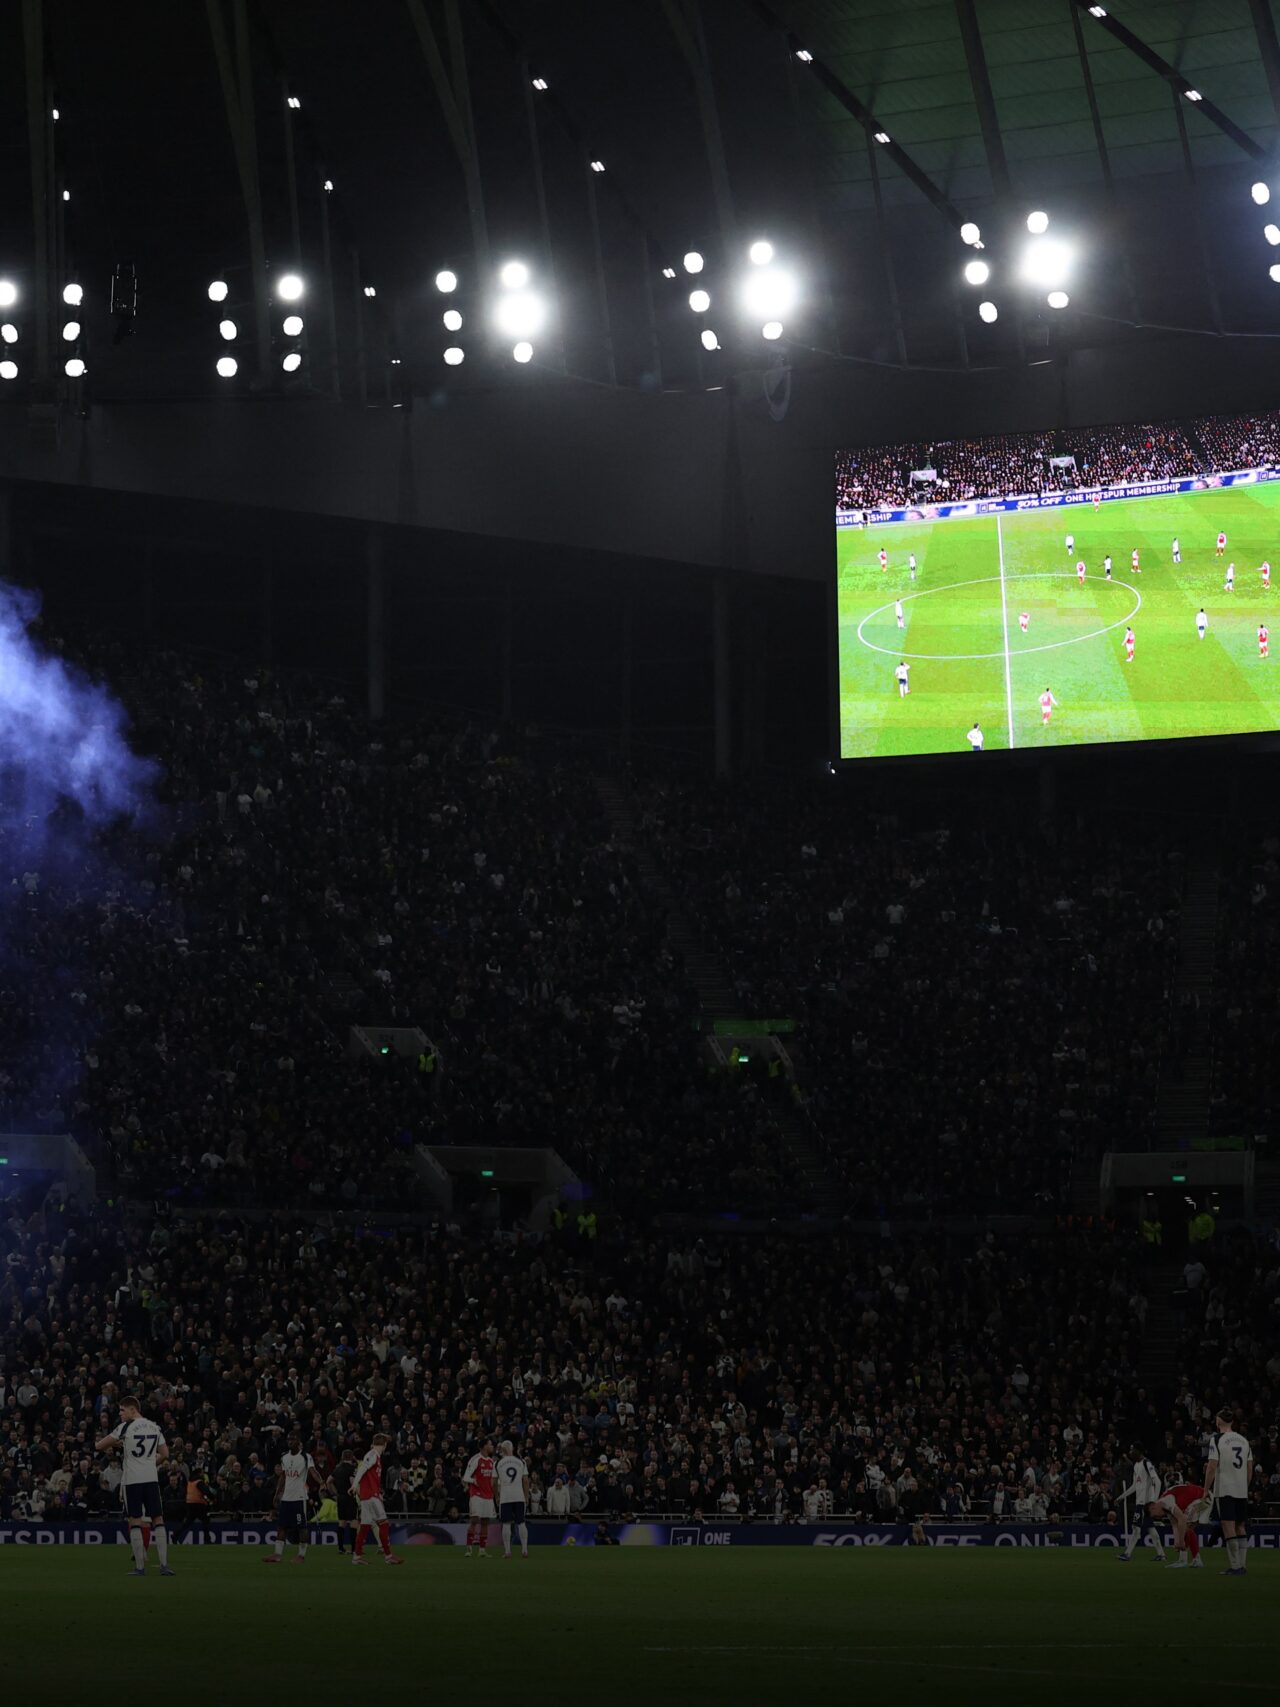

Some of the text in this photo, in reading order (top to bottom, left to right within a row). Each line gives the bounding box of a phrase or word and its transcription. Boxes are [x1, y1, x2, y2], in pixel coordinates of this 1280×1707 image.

[1017, 499, 1040, 508] 50%
[1041, 497, 1063, 507] OFF
[1065, 490, 1084, 503] ONE
[1126, 483, 1180, 497] MEMBERSHIP
[131, 1434, 158, 1458] 37
[1231, 1446, 1243, 1469] 3
[506, 1467, 517, 1484] 9
[704, 1532, 731, 1545] ONE
